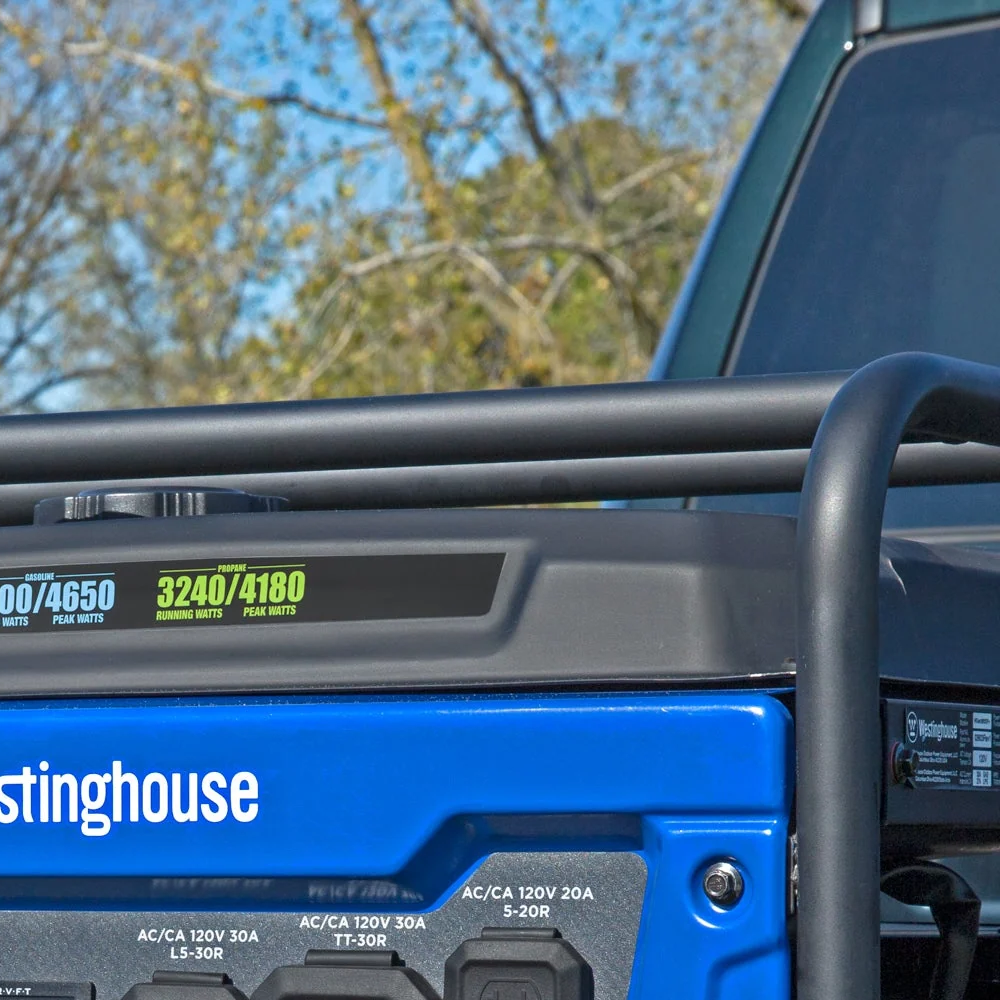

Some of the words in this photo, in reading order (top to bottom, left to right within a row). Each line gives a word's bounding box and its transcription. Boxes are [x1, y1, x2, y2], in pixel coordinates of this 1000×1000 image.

[218, 564, 247, 573] PROPANE
[25, 573, 55, 581] GASOLINE
[157, 571, 306, 608] 3240/4180
[156, 610, 193, 621] RUNNING
[195, 608, 223, 619] WATTS
[243, 606, 266, 617] PEAK
[268, 605, 296, 616] WATTS
[2, 616, 29, 627] WATTS
[52, 615, 75, 625] PEAK
[77, 613, 104, 624] WATTS
[462, 885, 513, 901] AC/CA
[518, 886, 557, 900] 120V
[560, 886, 594, 900] 20A
[503, 904, 550, 918] 5-20R
[299, 914, 349, 930] AC/CA
[354, 916, 391, 929] 120V
[394, 916, 426, 930] 30A
[137, 928, 185, 943] AC/CA
[190, 929, 225, 942] 120V
[229, 929, 259, 943] 30A
[334, 933, 387, 947] TT-30R
[170, 947, 224, 960] L5-30R
